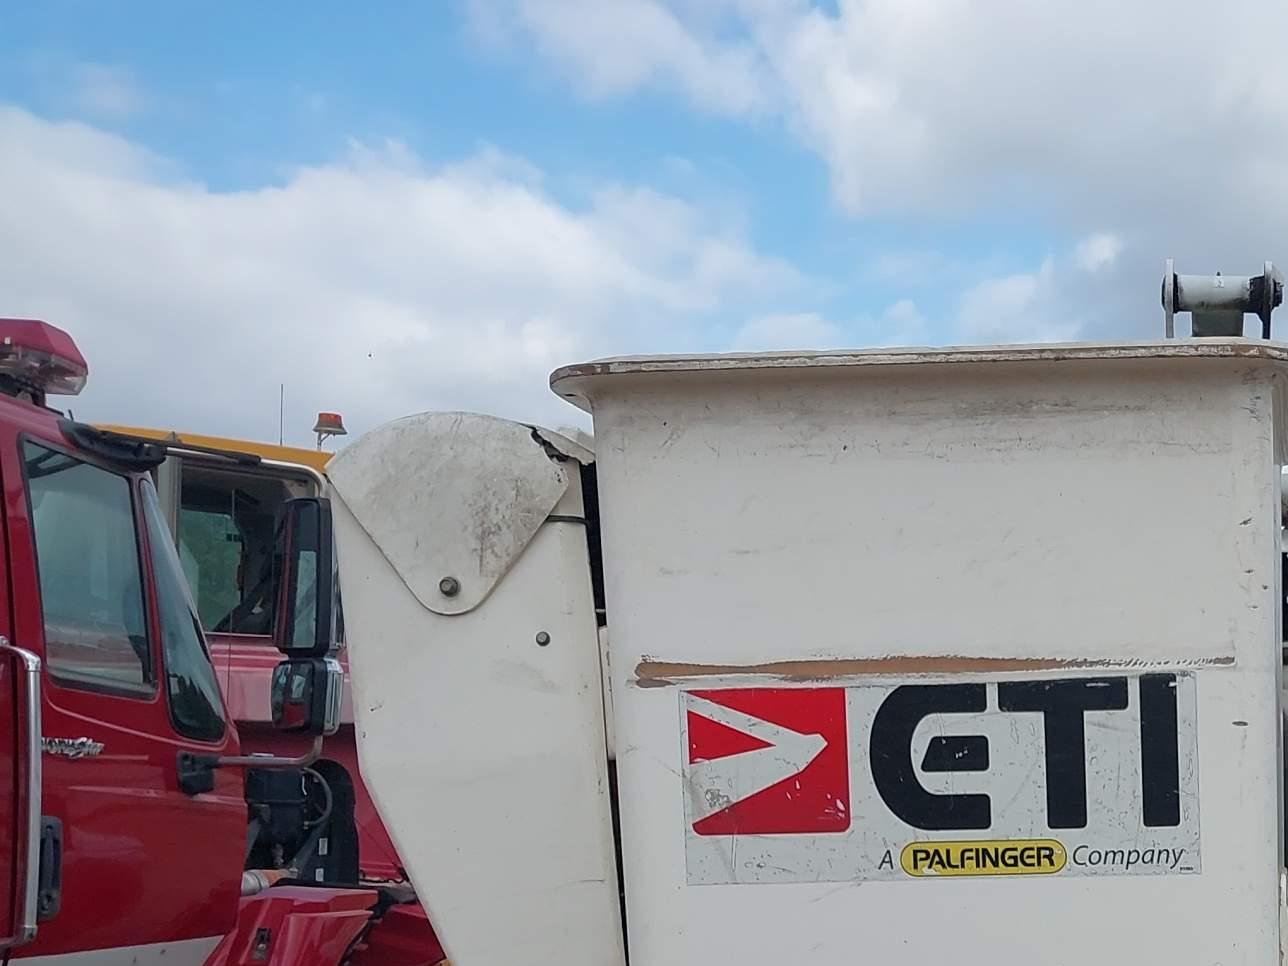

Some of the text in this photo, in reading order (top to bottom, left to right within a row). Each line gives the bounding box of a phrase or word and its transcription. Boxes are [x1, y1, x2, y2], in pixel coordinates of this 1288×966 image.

[869, 673, 1181, 831] ETI
[879, 844, 1185, 870] A PALFINGER Company
